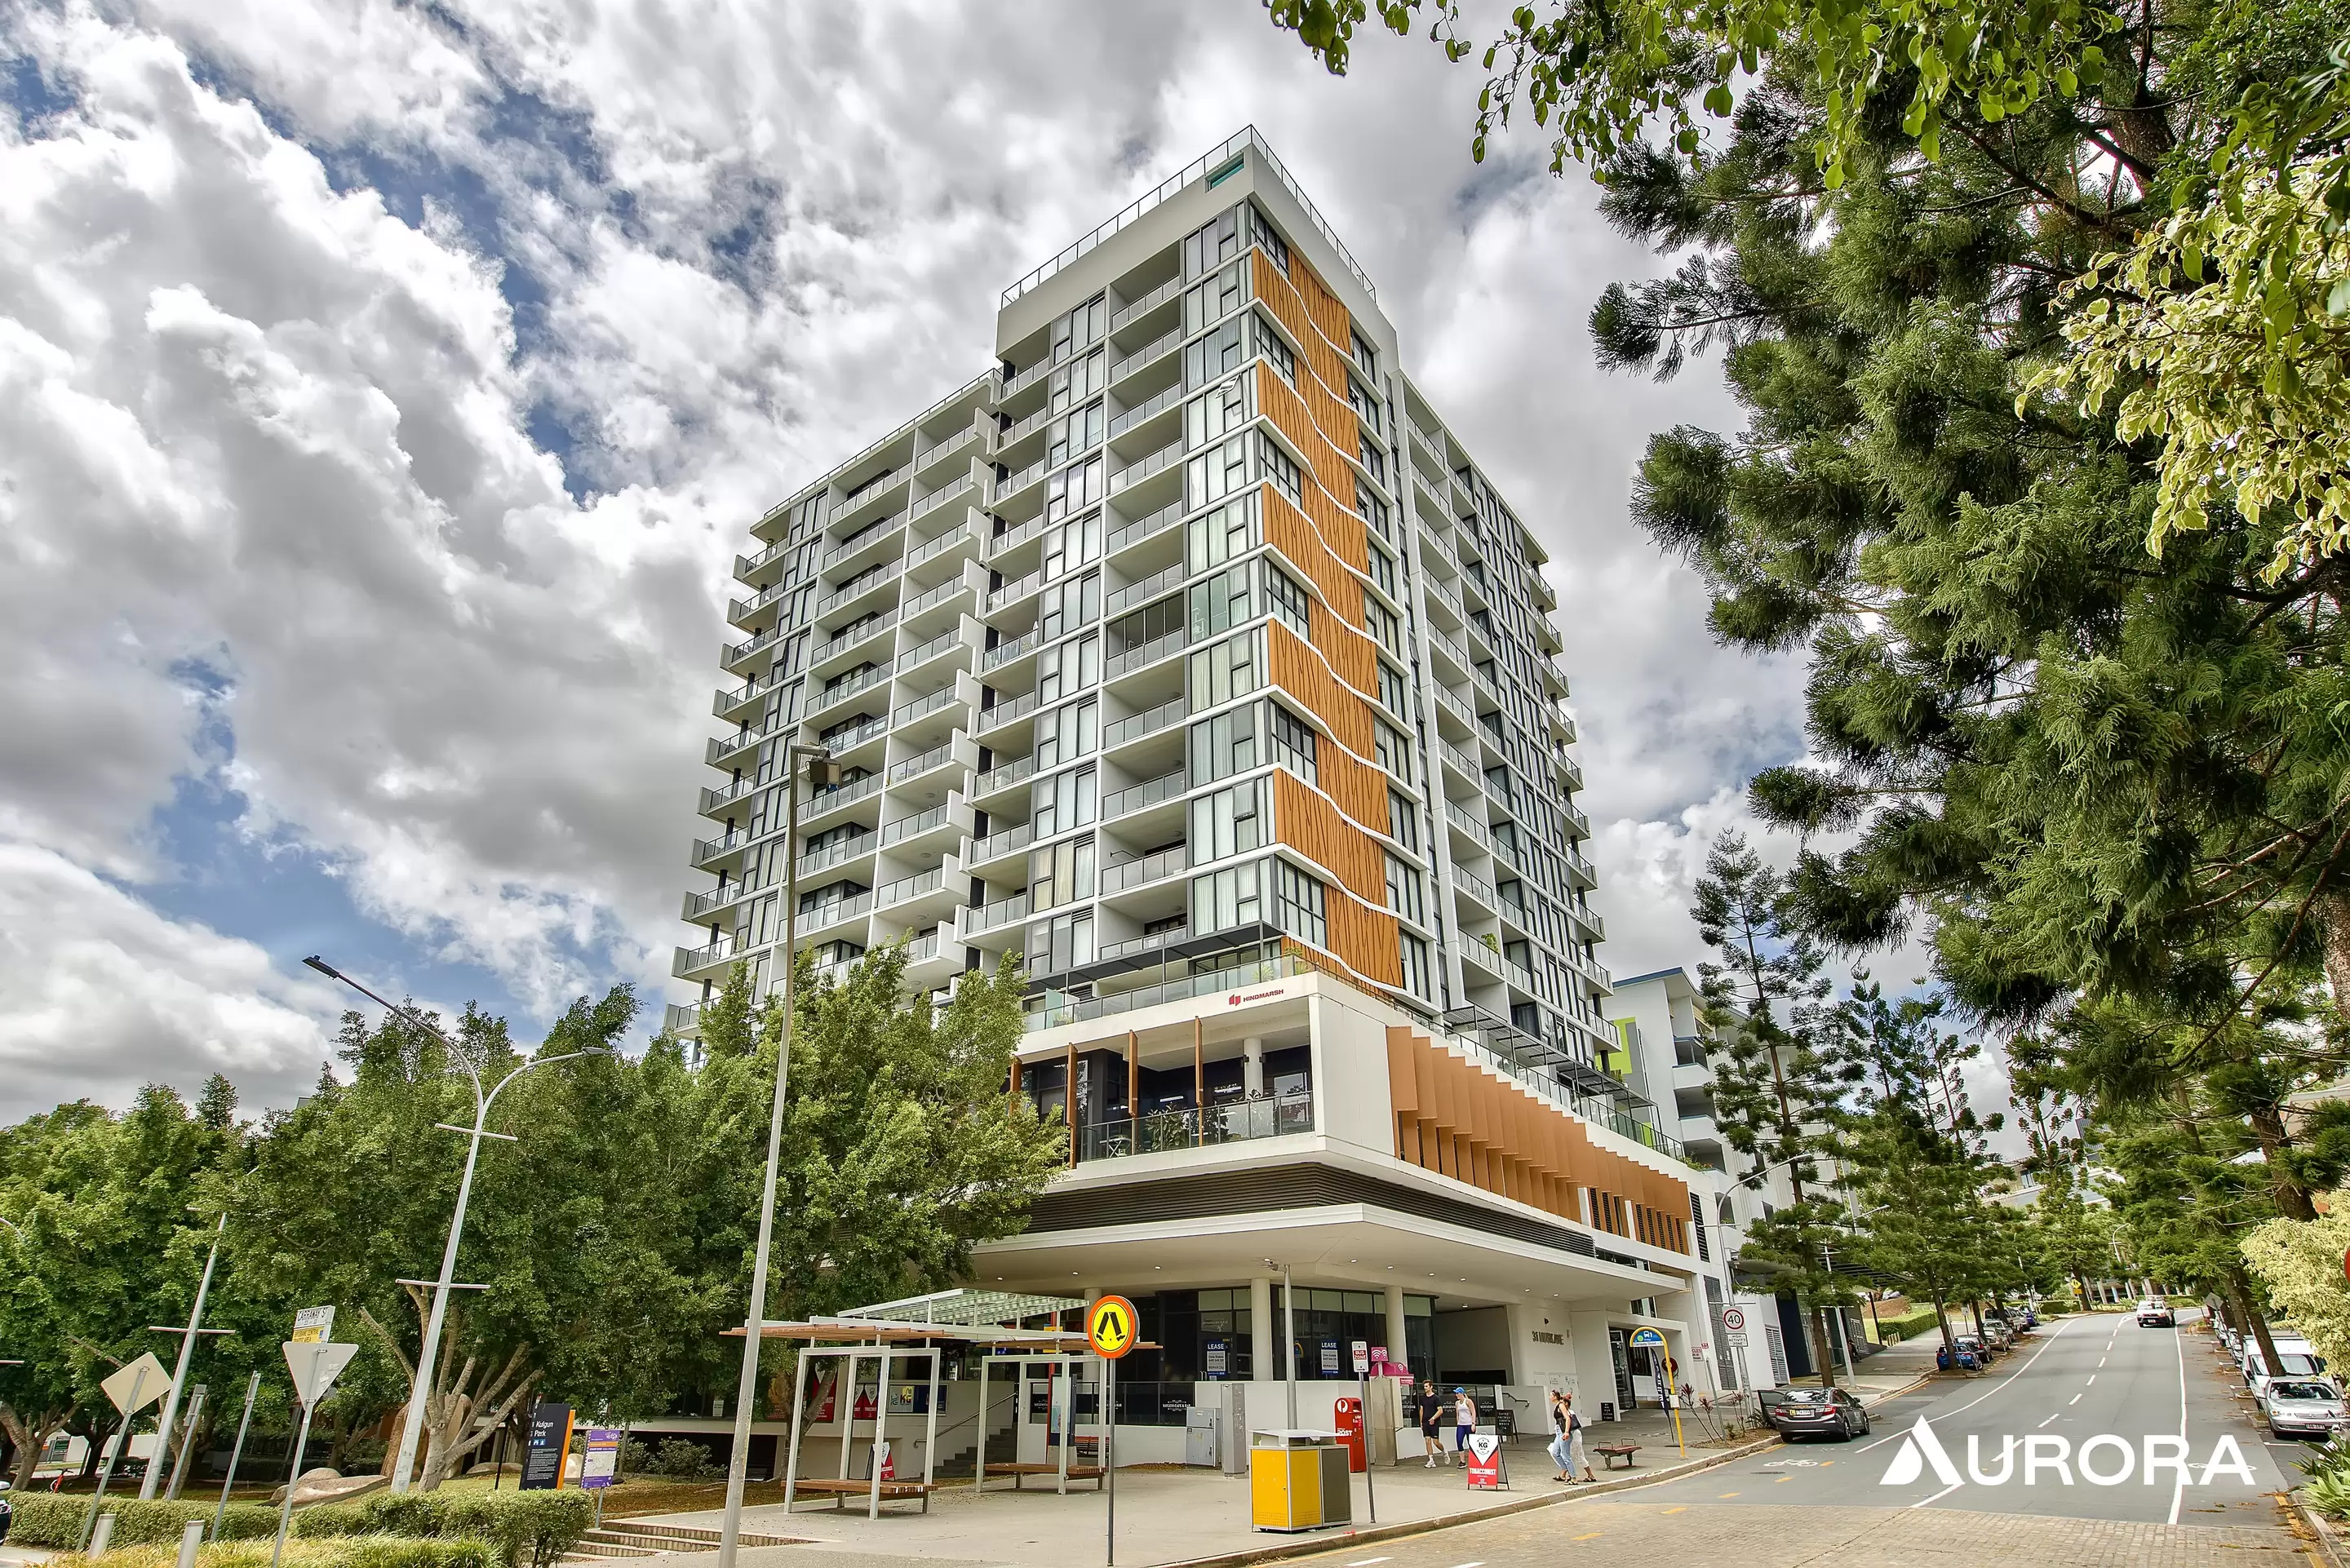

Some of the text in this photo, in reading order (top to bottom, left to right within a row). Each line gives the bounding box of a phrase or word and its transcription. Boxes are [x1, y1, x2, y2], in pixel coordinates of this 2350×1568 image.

[1244, 989, 1284, 1002] HINDMARSH
[1727, 1314, 1740, 1324] 40
[535, 1420, 553, 1429] Kulgun
